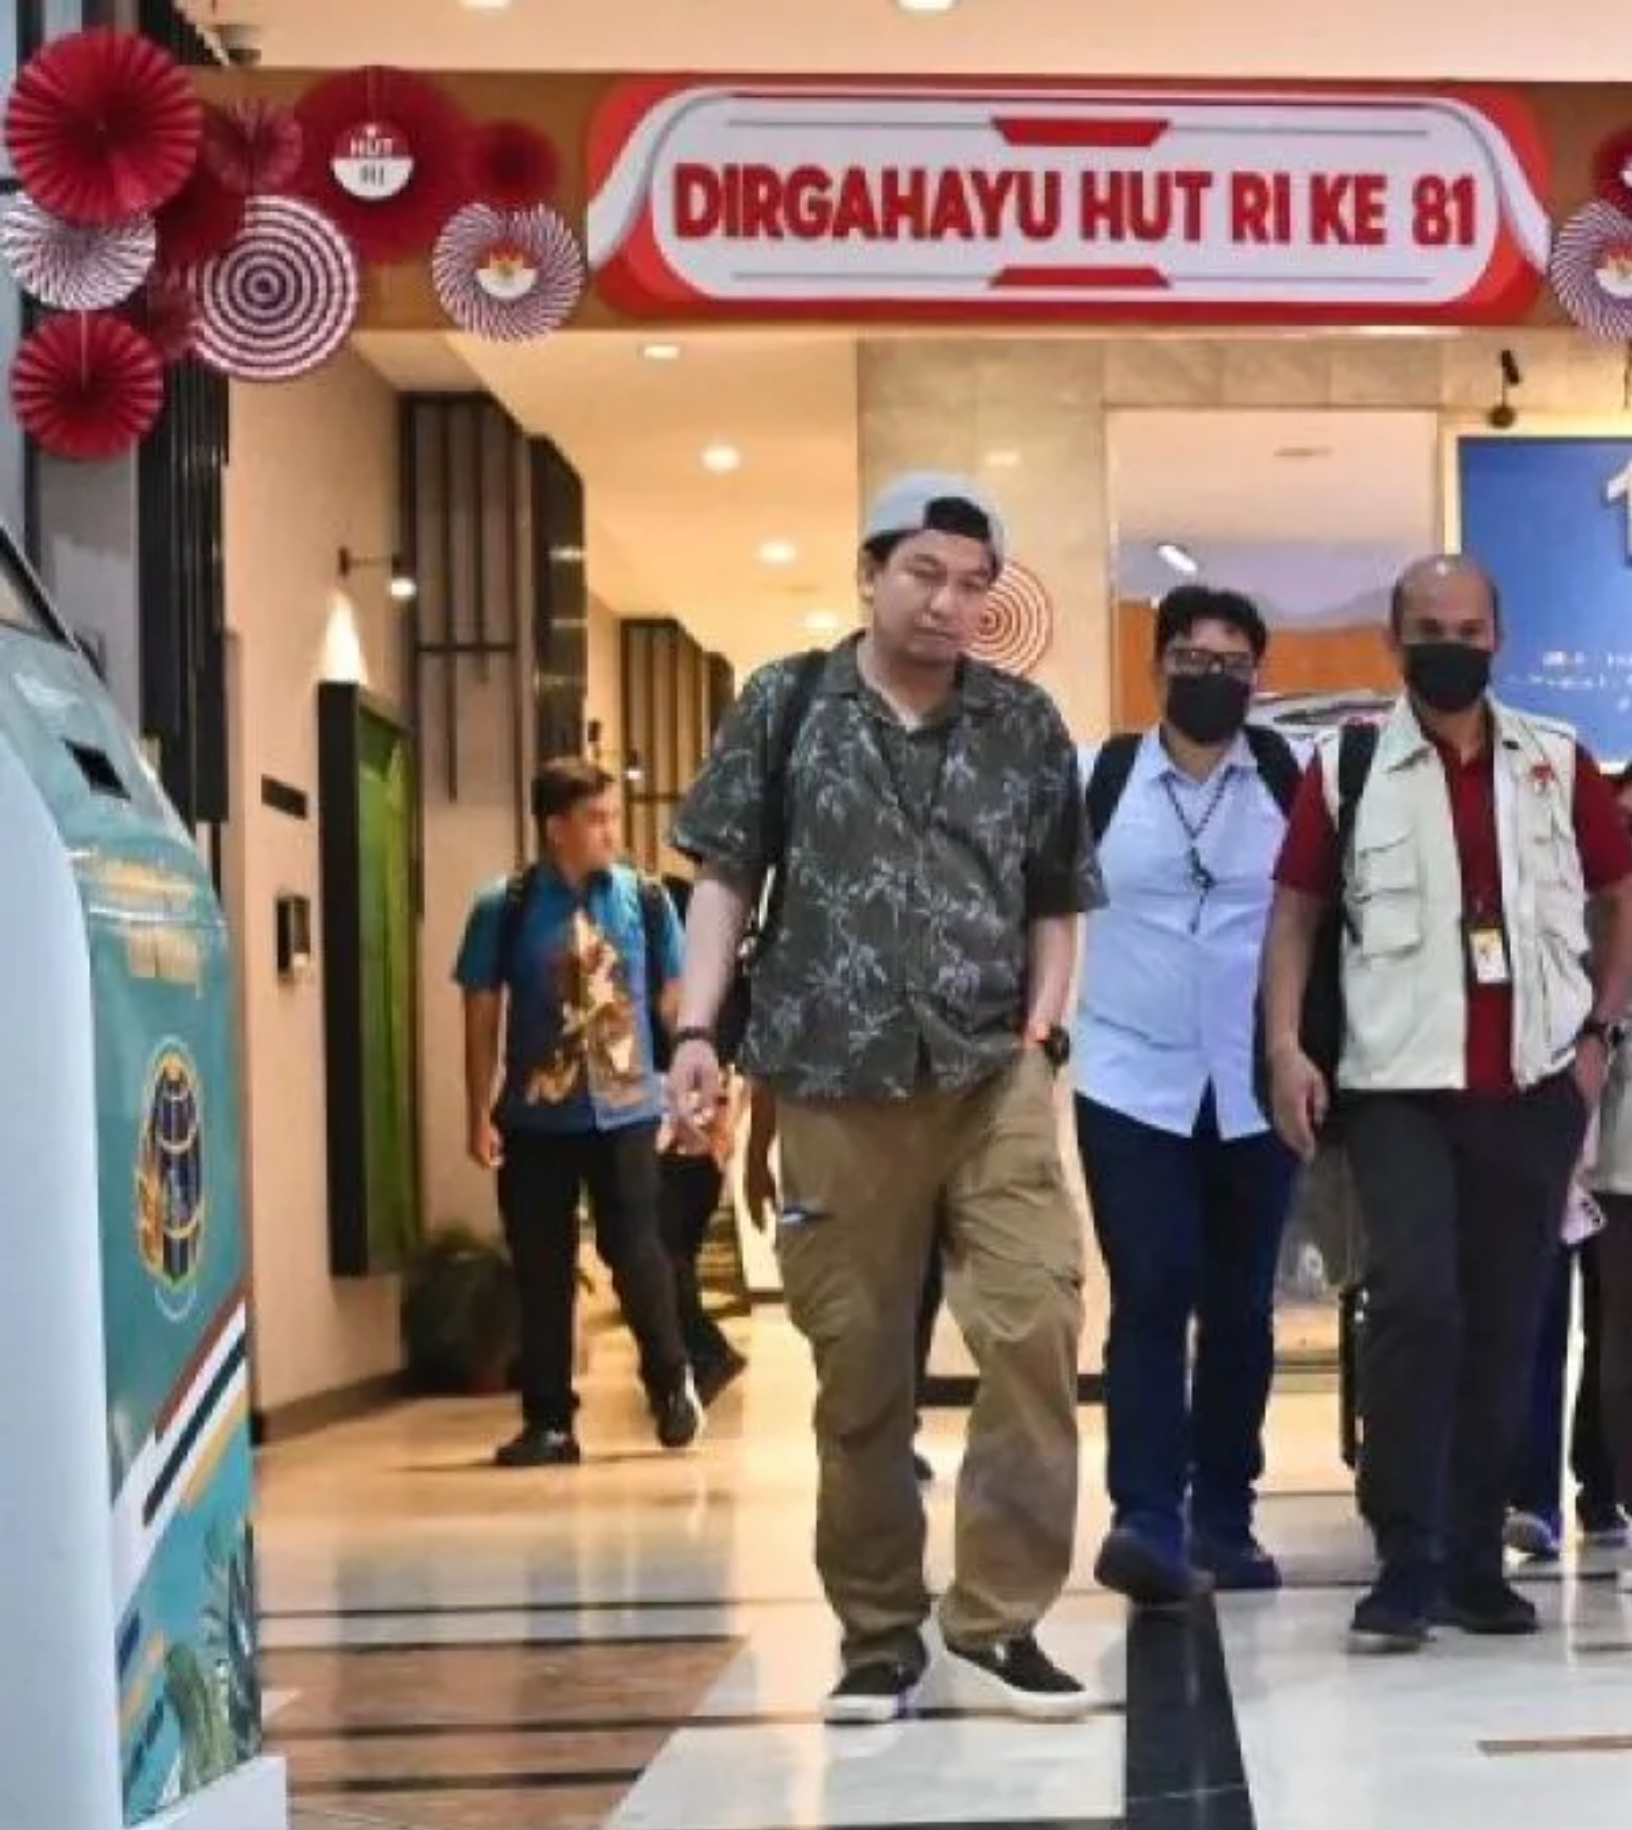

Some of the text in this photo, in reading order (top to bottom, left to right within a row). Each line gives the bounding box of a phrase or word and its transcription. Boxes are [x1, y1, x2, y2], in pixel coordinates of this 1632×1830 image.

[350, 137, 393, 156] HUT
[673, 162, 1475, 246] DIRGAHAYU HUT RI KE 81
